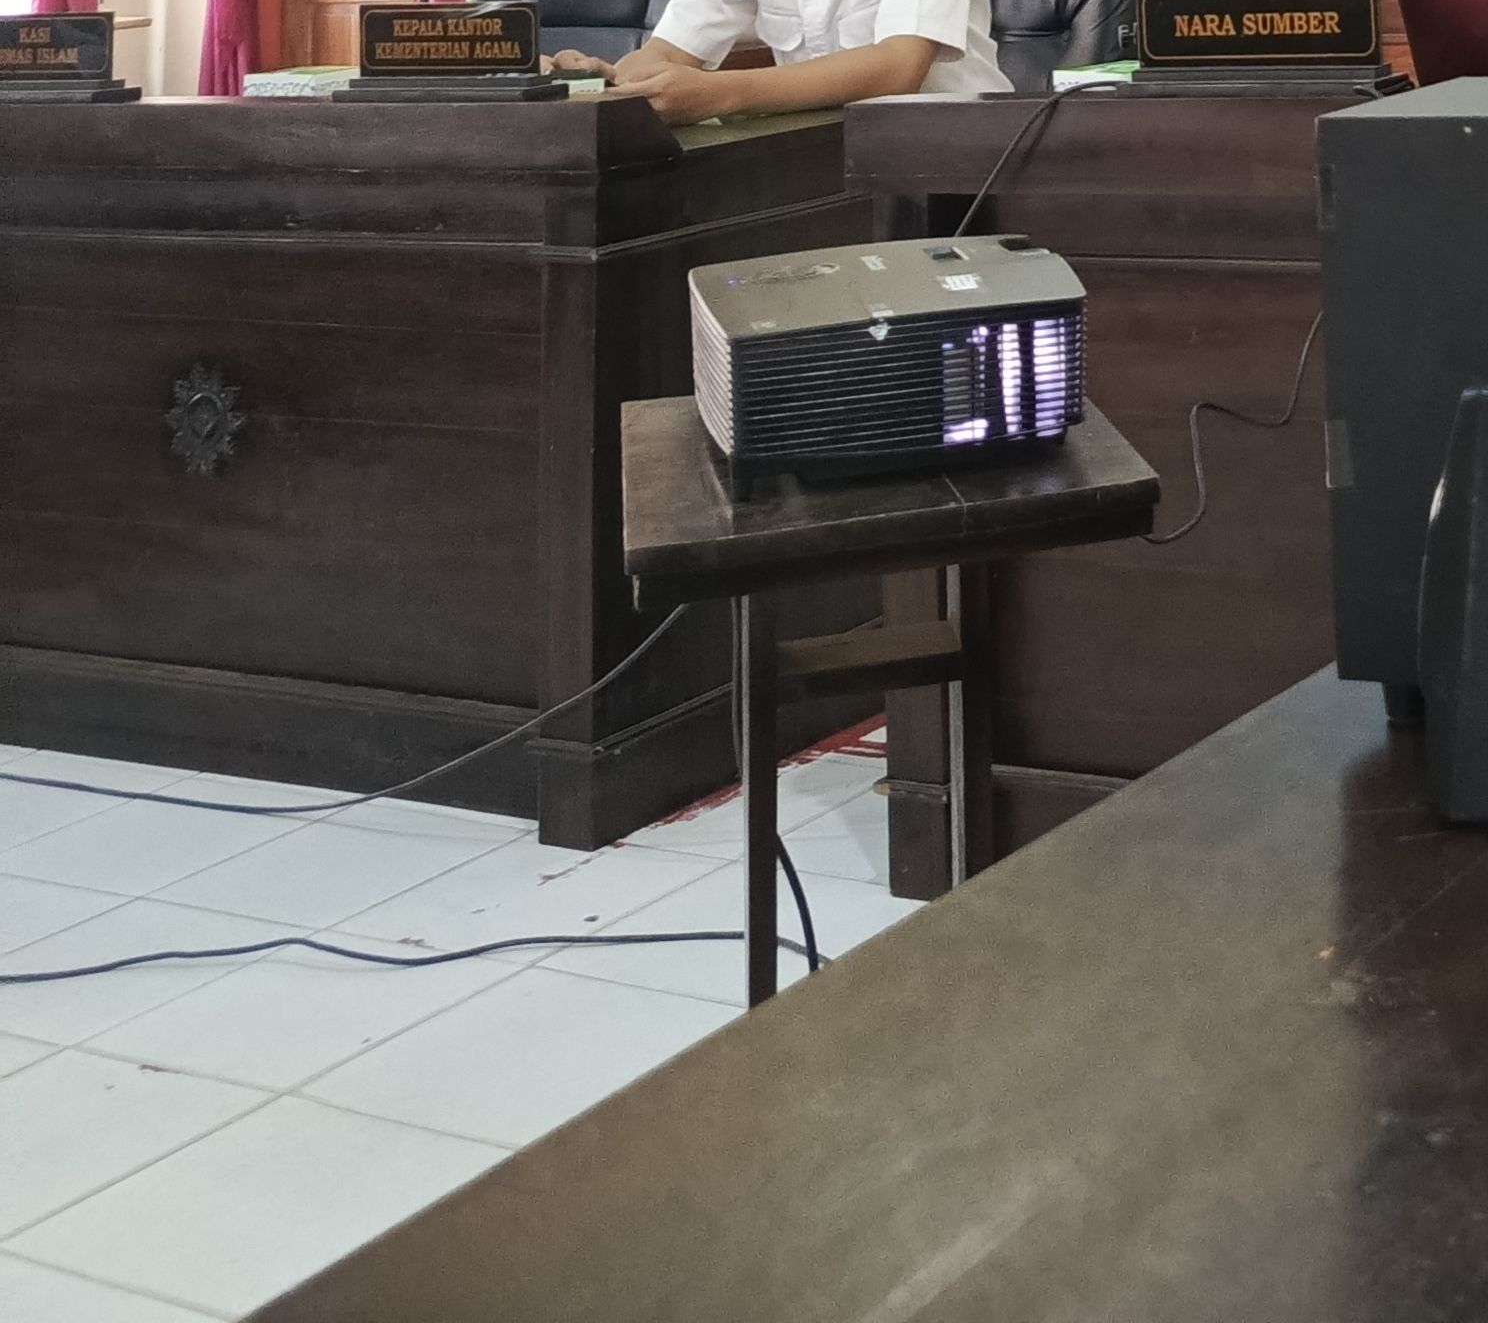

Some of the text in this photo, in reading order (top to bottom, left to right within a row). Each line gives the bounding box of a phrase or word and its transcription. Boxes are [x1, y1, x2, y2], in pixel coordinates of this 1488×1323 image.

[393, 18, 503, 36] KEPALA KANTOR
[1174, 11, 1341, 37] NARA SUMBER
[37, 47, 79, 63] ISLAM
[375, 41, 521, 60] KEMENTERIAN AGAMA
